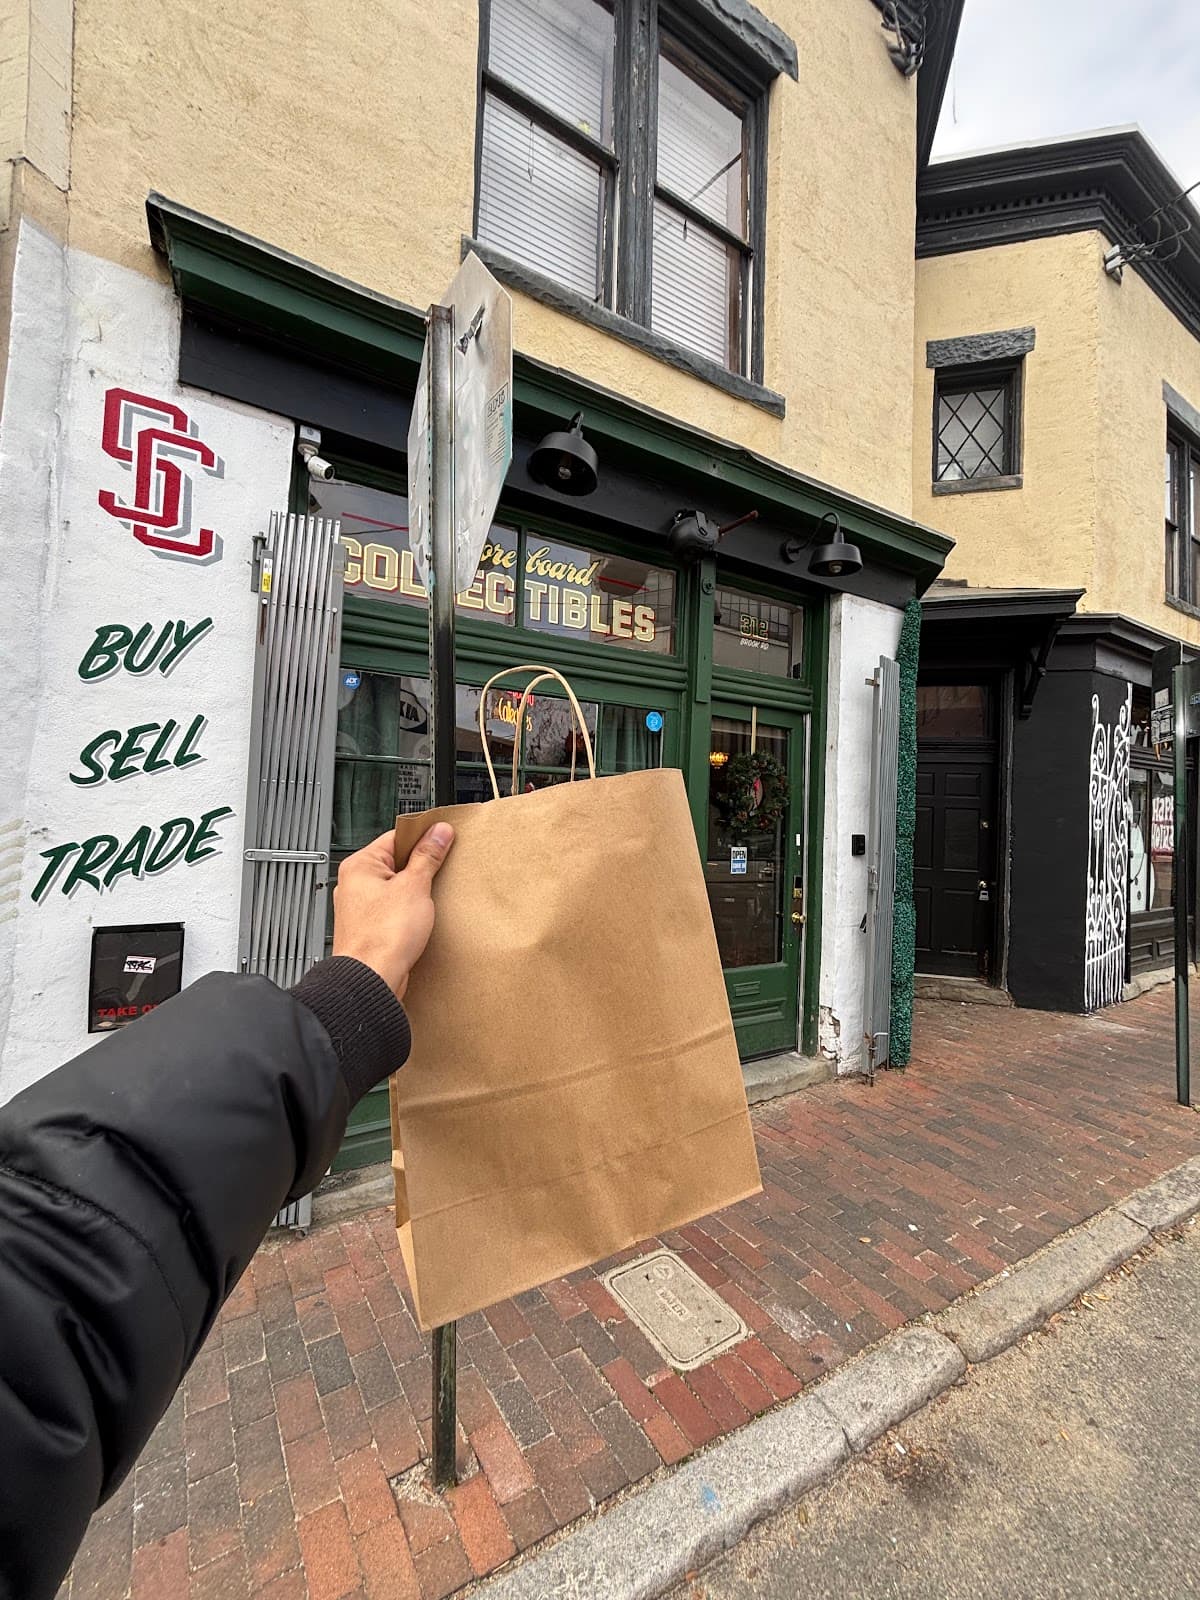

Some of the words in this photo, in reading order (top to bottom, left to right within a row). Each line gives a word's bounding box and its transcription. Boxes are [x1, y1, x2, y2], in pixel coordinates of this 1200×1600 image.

[341, 536, 656, 643] COLECTIBLES
[481, 542, 517, 569] ore
[525, 546, 600, 587] board
[77, 616, 214, 684] BUY
[740, 614, 769, 641] 312
[69, 714, 208, 788] SELL
[30, 806, 236, 906] TRADE
[97, 1005, 138, 1019] TAKE
